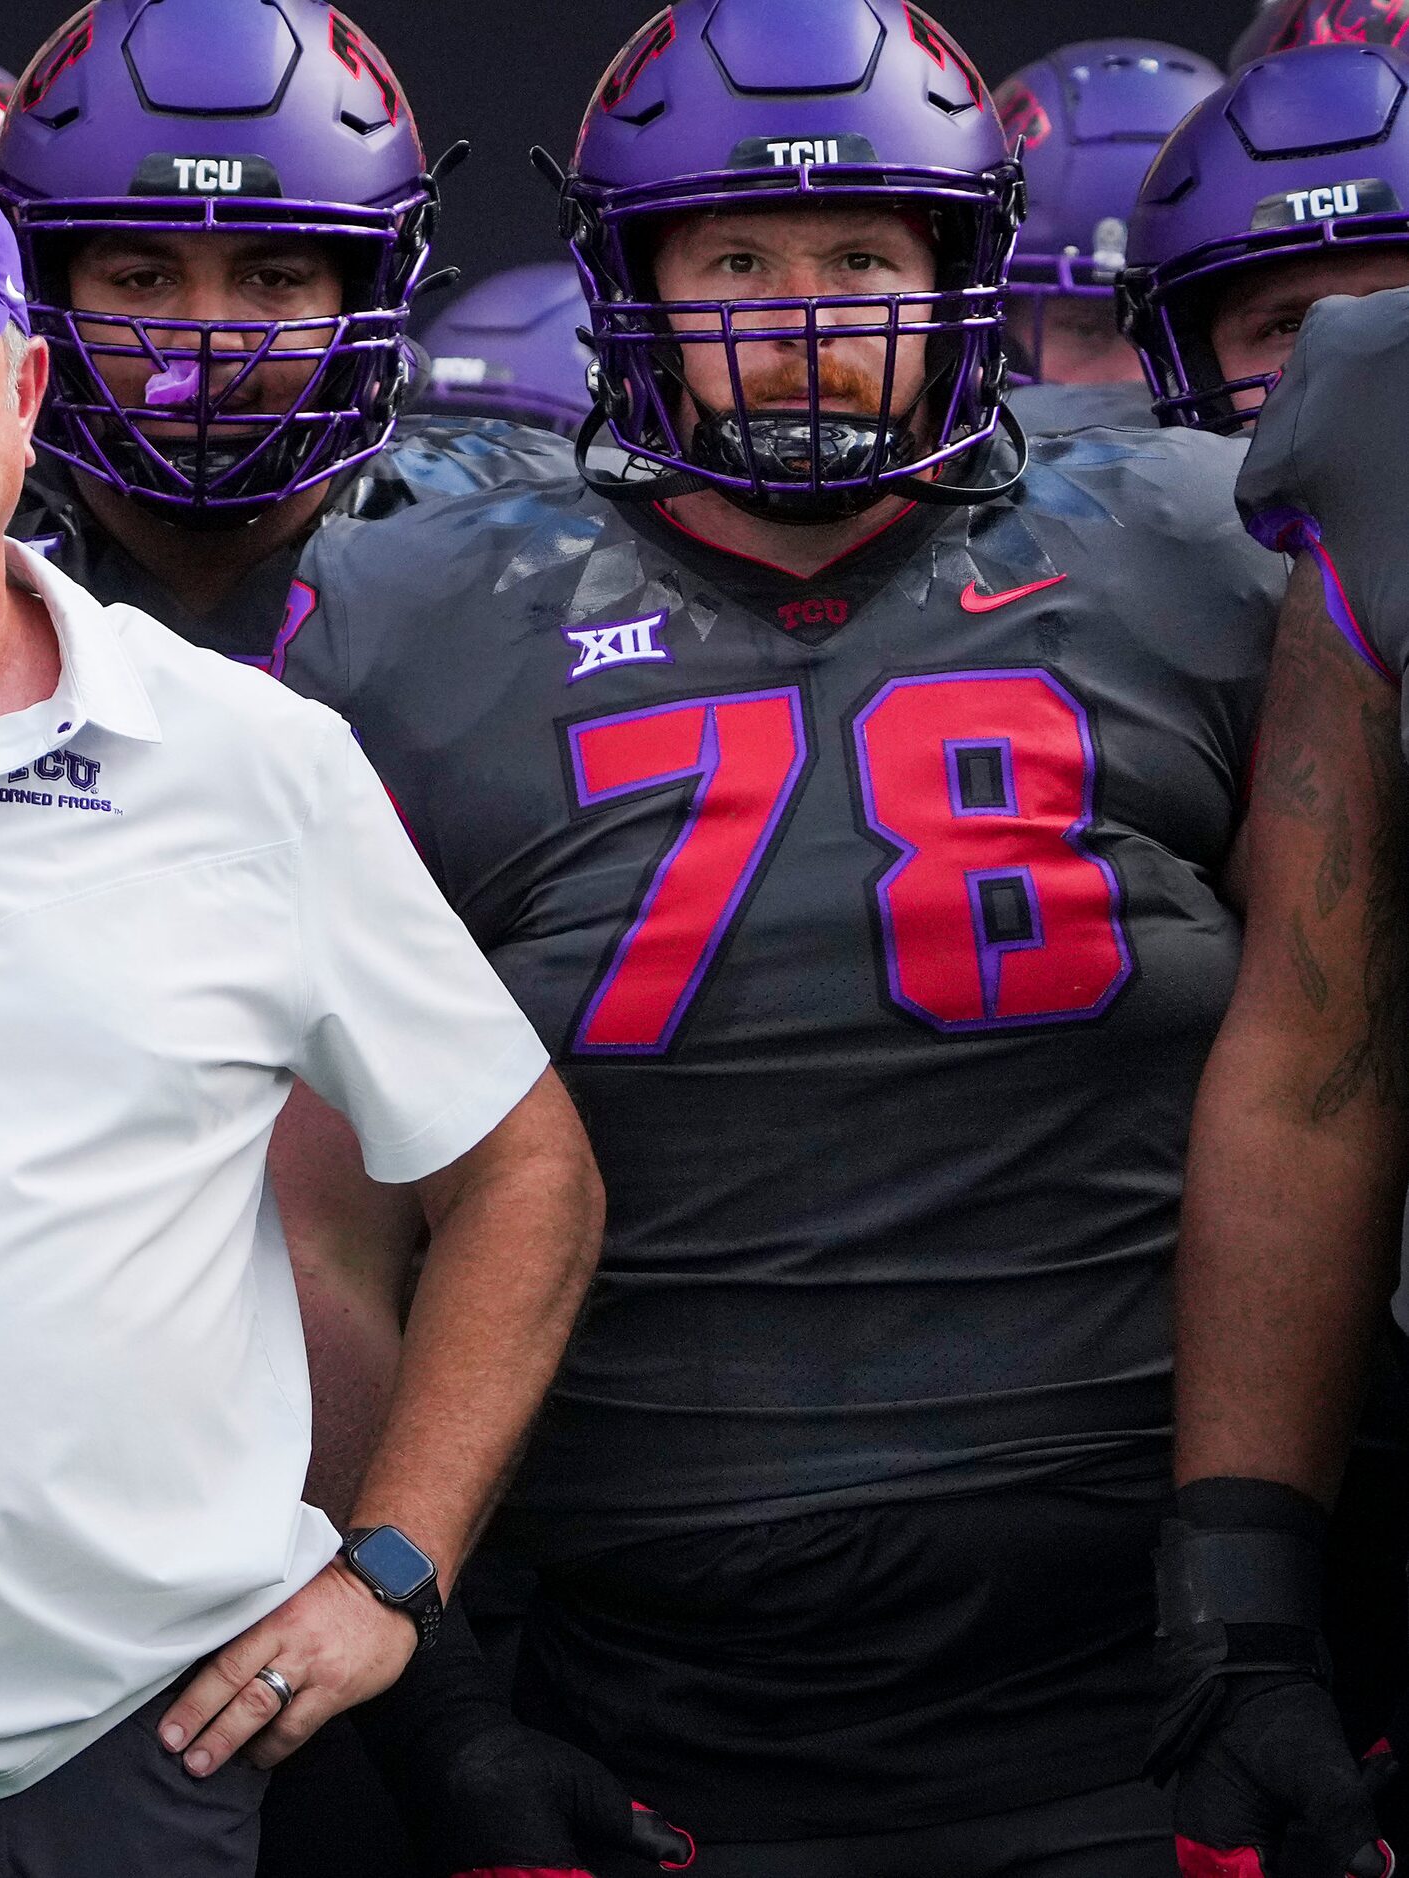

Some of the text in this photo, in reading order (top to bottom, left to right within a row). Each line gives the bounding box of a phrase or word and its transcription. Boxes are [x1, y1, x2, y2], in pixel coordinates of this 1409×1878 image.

[767, 139, 838, 166] TCU
[173, 158, 242, 190] TCU
[1285, 184, 1359, 221] TCU
[777, 599, 848, 632] TCU
[567, 614, 667, 677] XII
[58, 794, 112, 812] FROGS
[567, 668, 1133, 1056] 78
